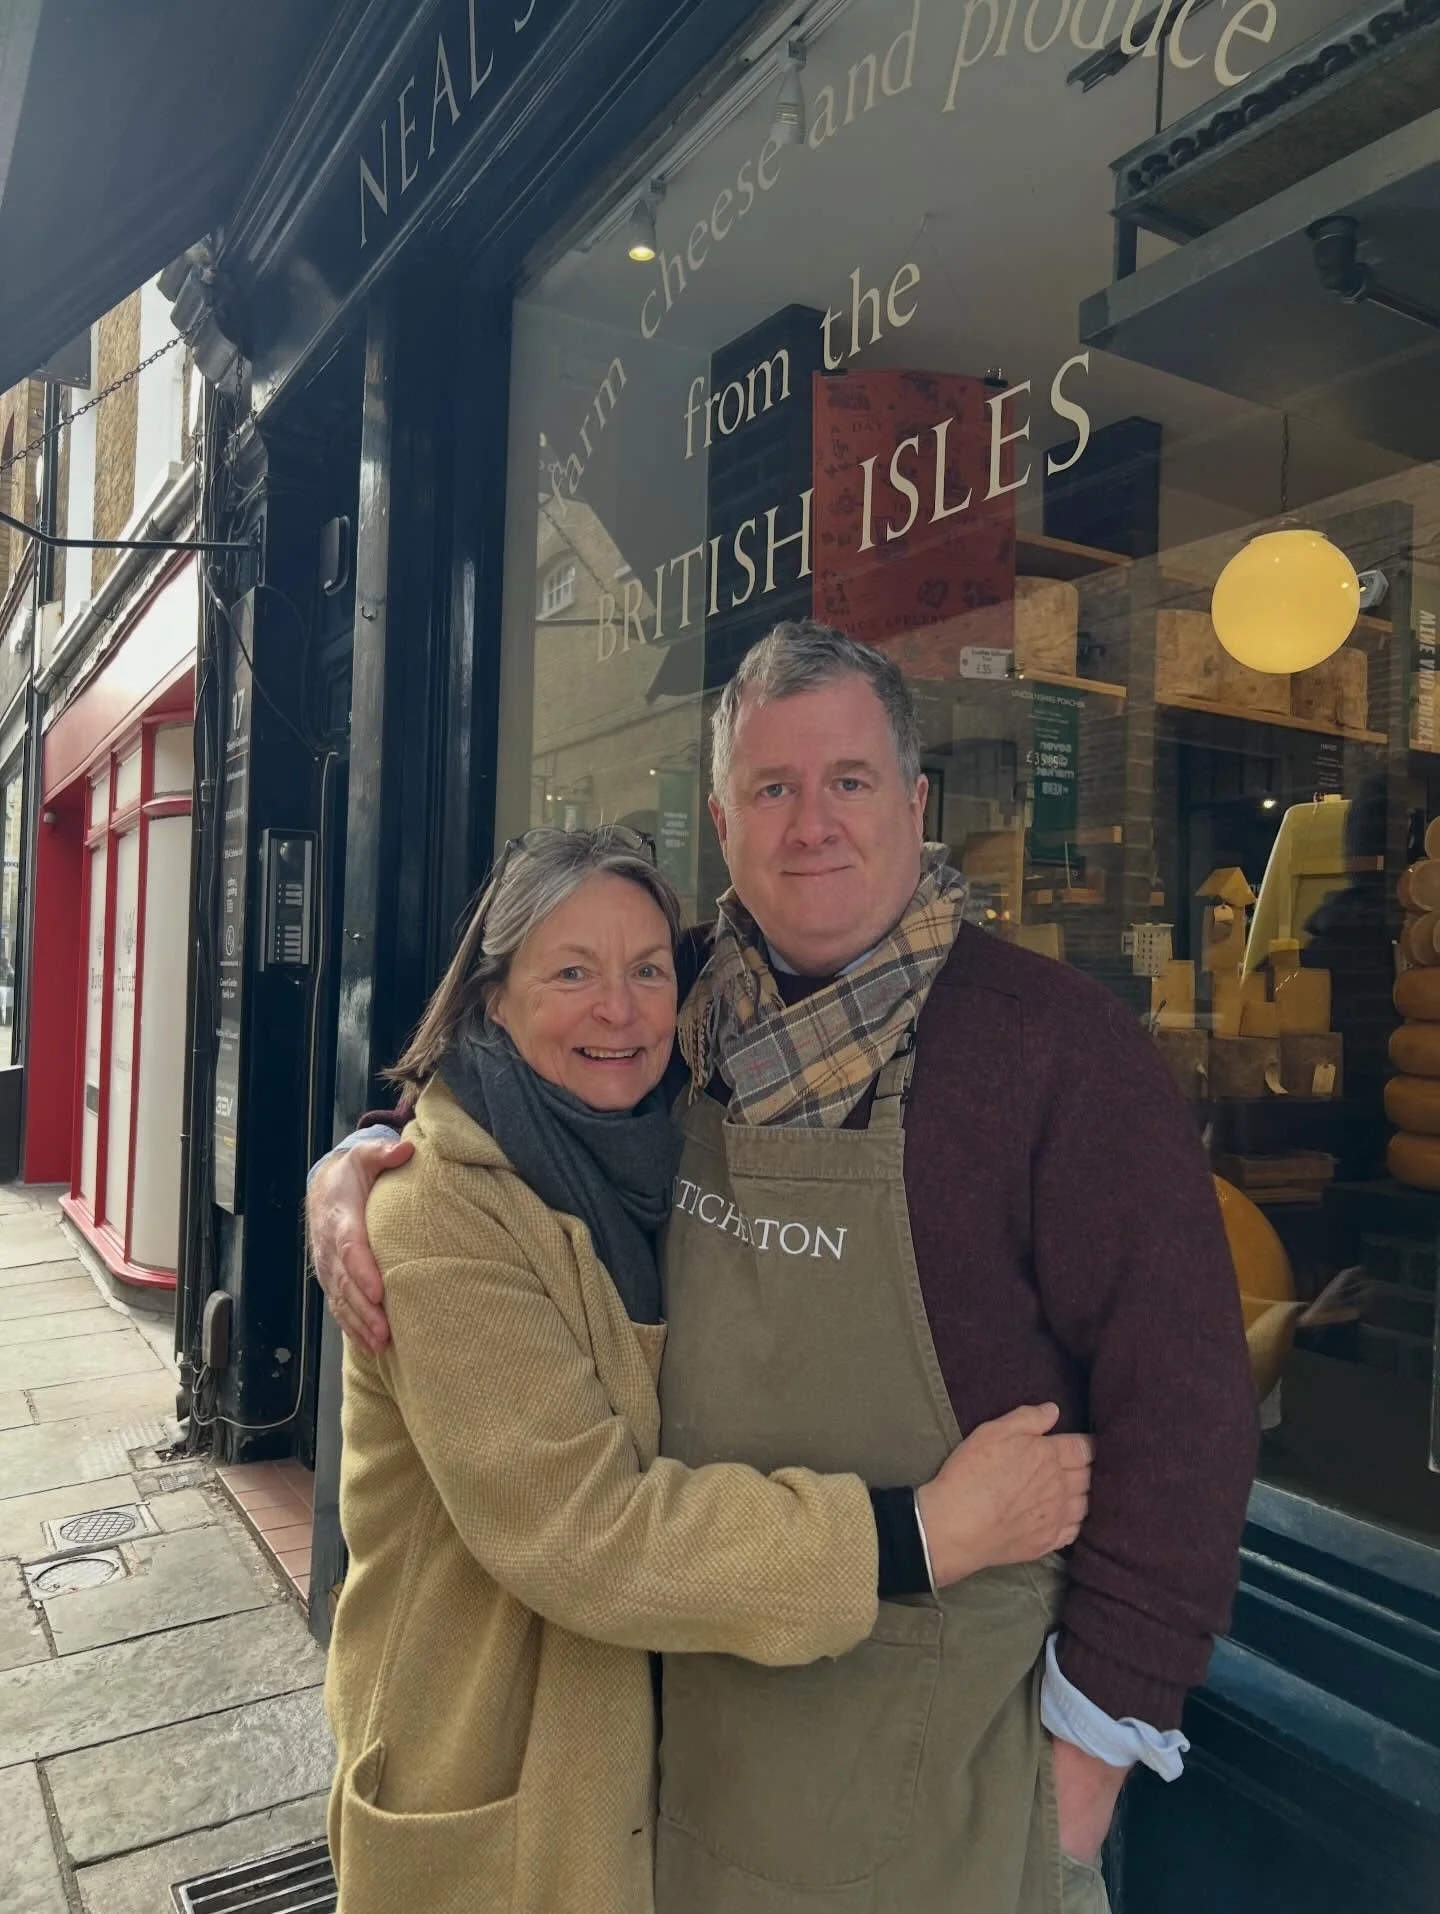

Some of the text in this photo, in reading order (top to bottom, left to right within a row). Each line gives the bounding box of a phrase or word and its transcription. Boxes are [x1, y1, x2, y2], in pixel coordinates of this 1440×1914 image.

[360, 0, 536, 249] NEAL
[549, 357, 627, 518] farm
[641, 136, 783, 339] cheese
[809, 0, 921, 150] and
[683, 263, 920, 460] from the
[598, 352, 1092, 663] BRITISH ISLES
[233, 688, 246, 730] 17
